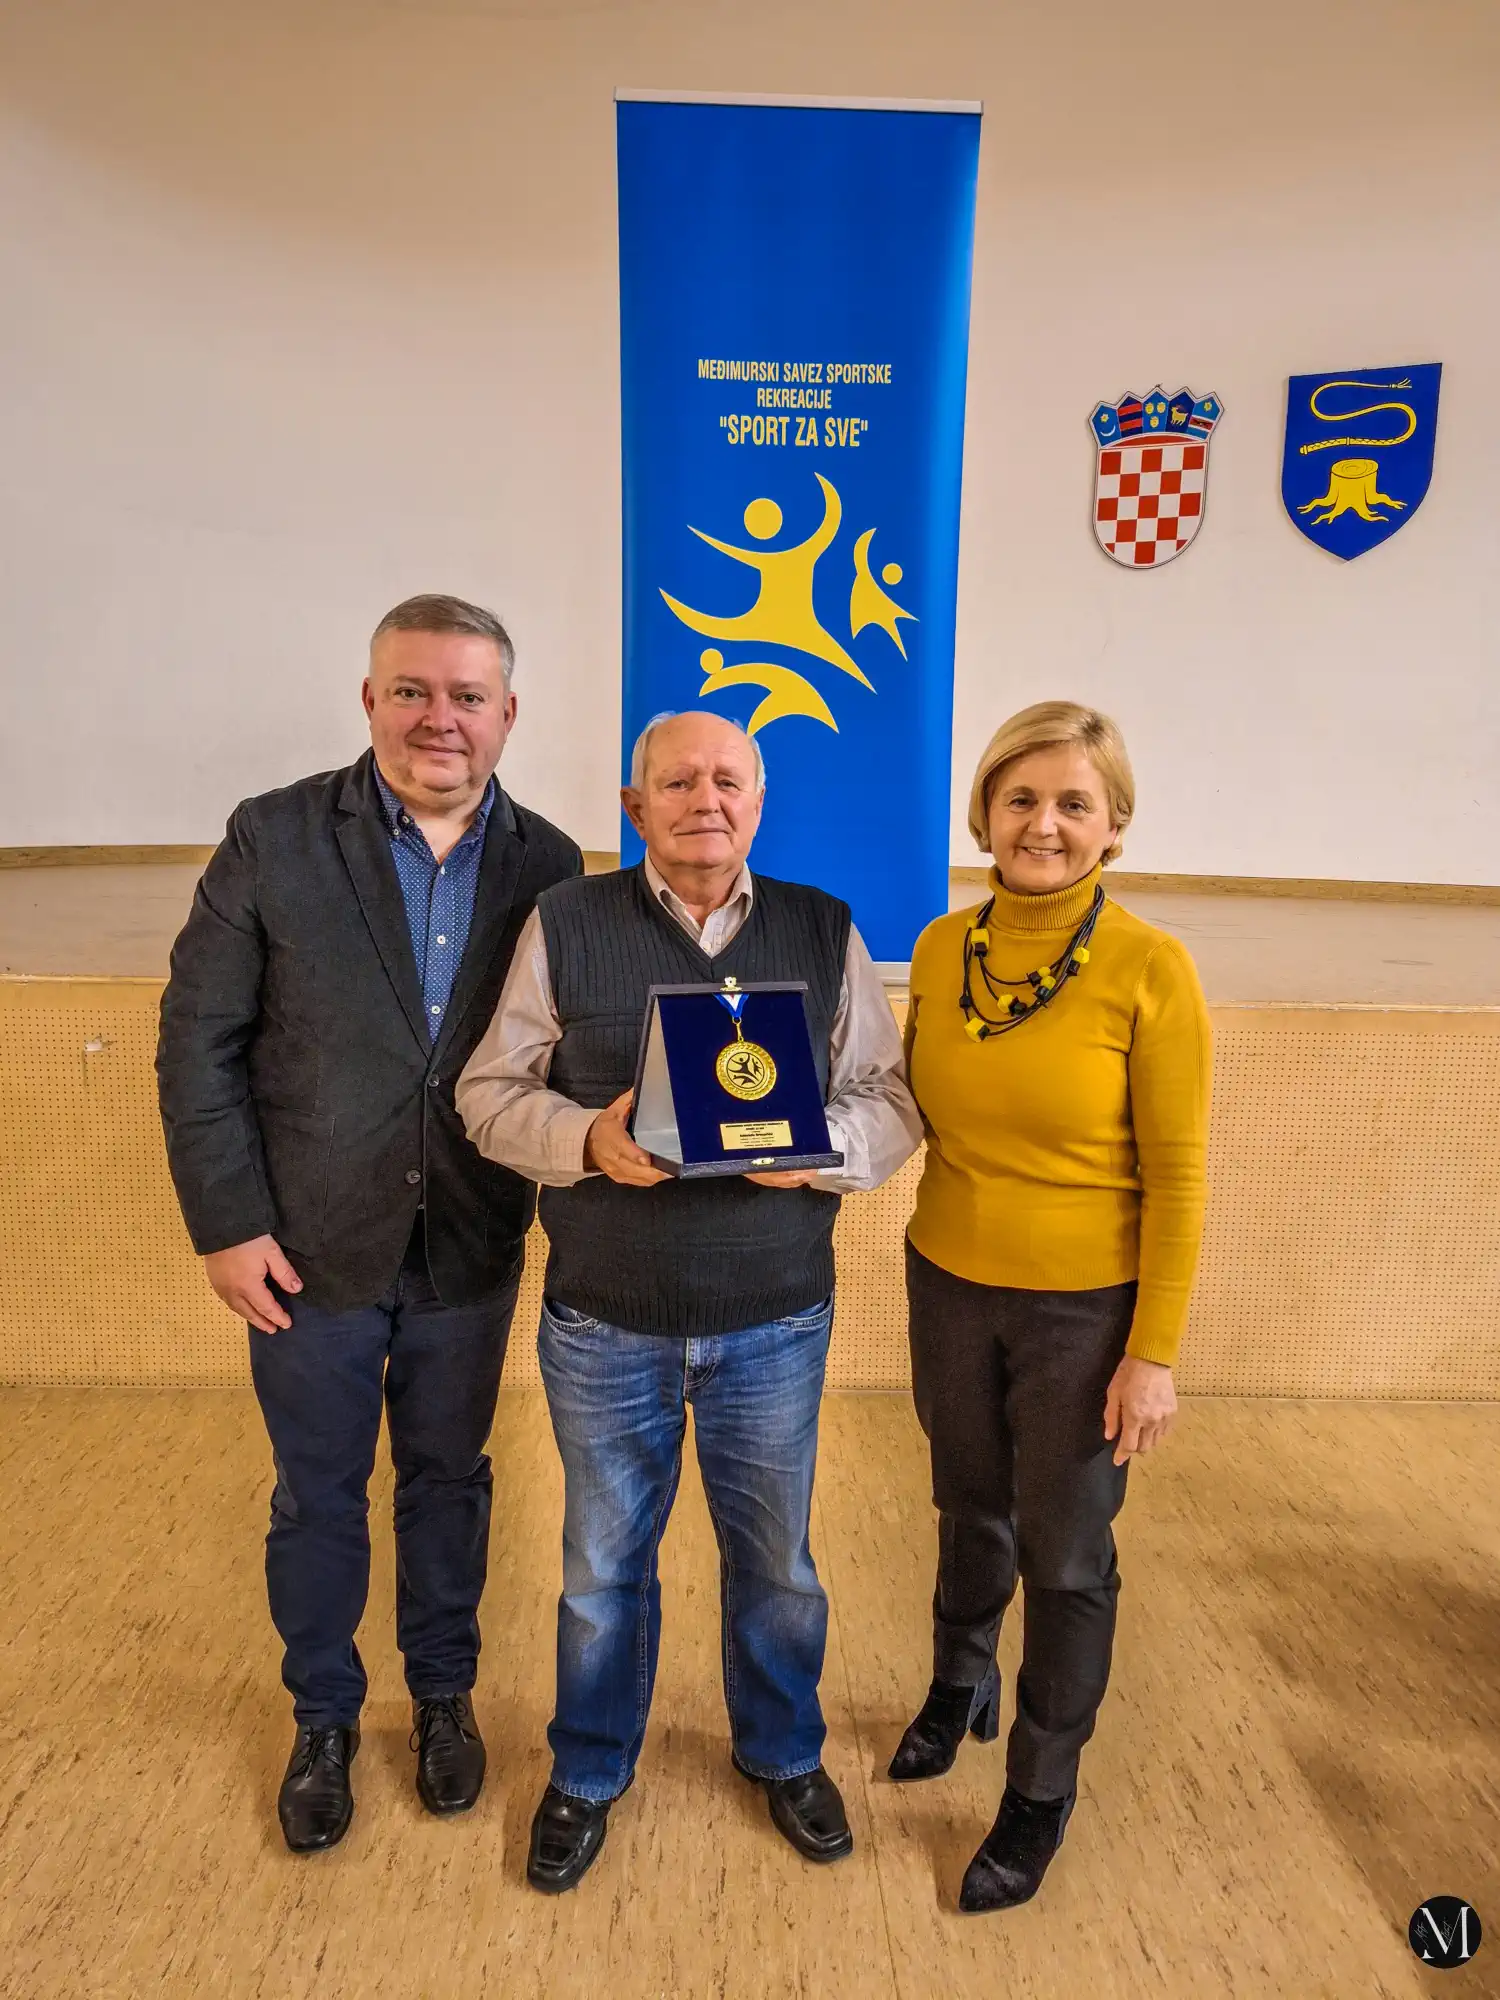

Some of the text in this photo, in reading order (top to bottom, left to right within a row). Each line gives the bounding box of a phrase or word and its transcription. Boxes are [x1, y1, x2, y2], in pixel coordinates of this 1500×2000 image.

[698, 359, 892, 384] MEĐIMURSKI SAVEZ SPORTSKE
[756, 388, 832, 409] REKREACIJE
[719, 414, 869, 447] "SPORT ZA SVE"
